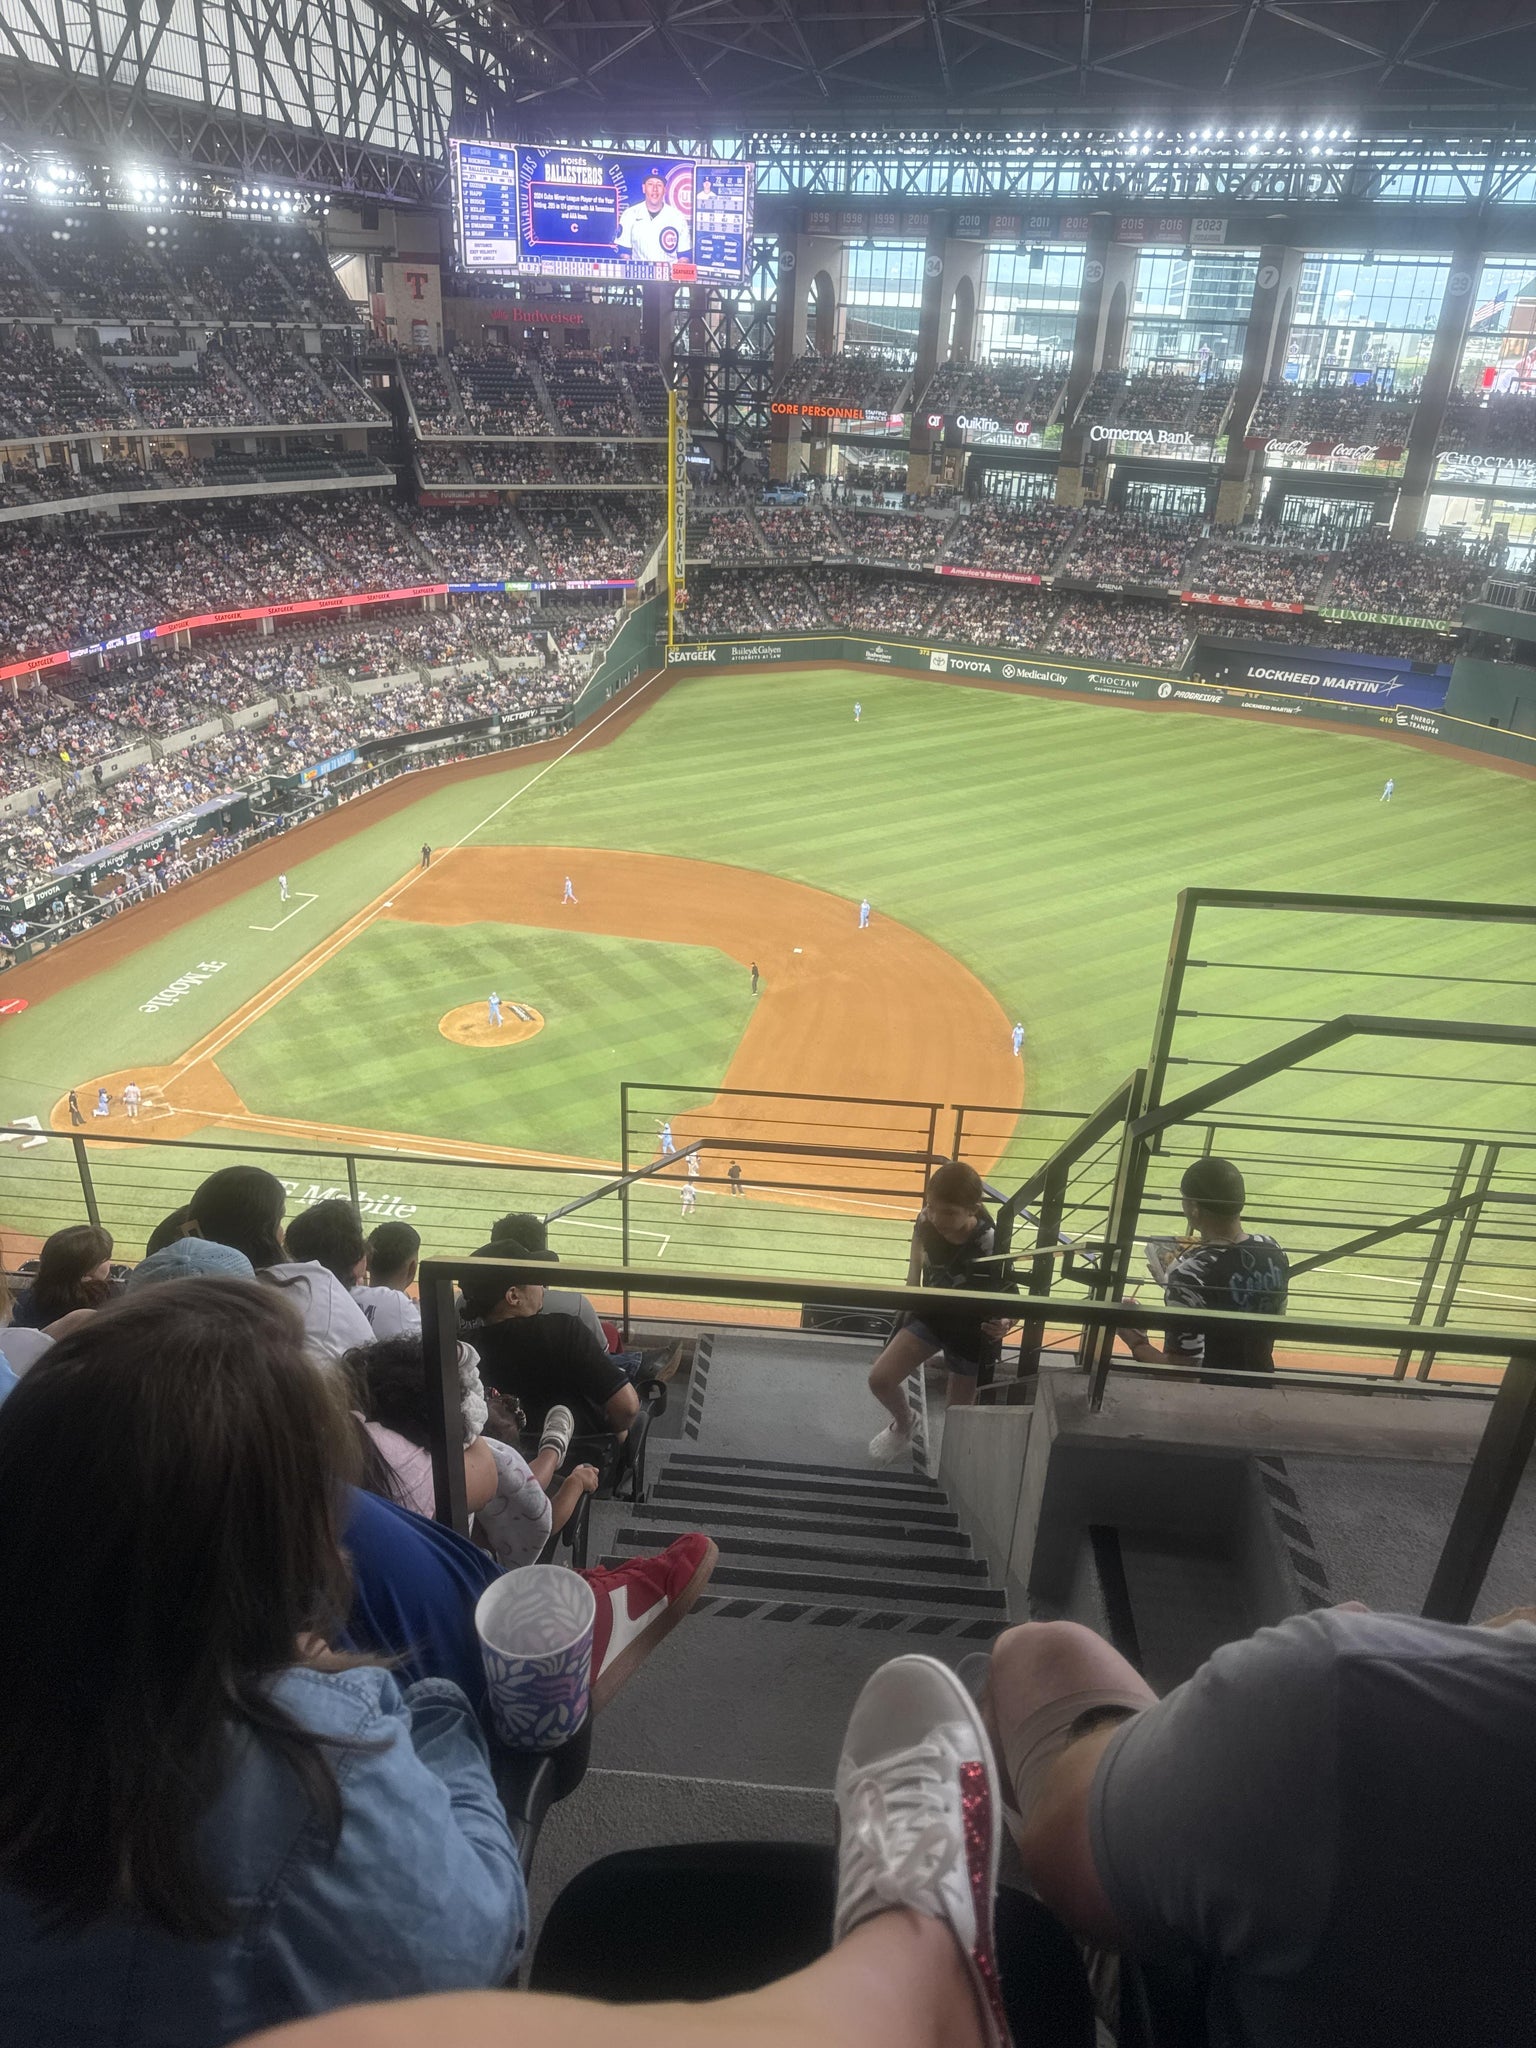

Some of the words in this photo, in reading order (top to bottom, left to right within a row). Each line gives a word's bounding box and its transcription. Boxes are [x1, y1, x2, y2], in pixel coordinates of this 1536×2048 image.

[561, 157, 587, 166] MOISÉS
[544, 163, 603, 185] BALLESTEROS
[1196, 220, 1223, 231] 2023
[927, 261, 941, 273] 34
[1263, 270, 1273, 285] 7
[404, 272, 429, 300] T
[513, 308, 582, 324] Budweiser
[771, 403, 799, 415] CORE
[801, 405, 865, 420] PERSONNEL
[928, 415, 942, 427] QT
[956, 415, 1000, 433] QuikTrip
[1015, 422, 1030, 434] QT
[1158, 429, 1195, 445] Bank
[950, 567, 985, 578] America's
[985, 571, 1001, 580] Best
[1002, 572, 1032, 583] Network
[412, 587, 435, 595] SEATGEEK
[1096, 583, 1124, 591] ARENA
[367, 593, 391, 601] SEATGEEK
[1191, 592, 1211, 600] DEX
[1218, 595, 1238, 603] DEX
[1244, 598, 1265, 606] DEX
[268, 606, 294, 615] SEATGEEK
[318, 599, 344, 608] SEATGEEK
[214, 612, 242, 622] SEATGEEK
[1330, 608, 1378, 623] LUXOR
[1379, 613, 1446, 631] STAFFING
[668, 649, 717, 663] SEATGEEK
[950, 659, 992, 673] TOYOTA
[1016, 668, 1049, 681] Medical
[1050, 672, 1068, 685] City
[1087, 674, 1140, 688] CHOCTAW
[1247, 666, 1320, 685] LOCKHEED
[1322, 676, 1380, 694] MARTIN
[1173, 690, 1224, 704] PROGRESSIVE
[1241, 701, 1271, 711] LOCKHEED
[1270, 705, 1293, 713] MARTIN
[501, 709, 535, 723] VICTORY
[1379, 716, 1393, 724] 410
[1410, 714, 1435, 725] ENERGY
[1408, 721, 1439, 734] TRANSFER
[143, 836, 164, 851] Kroger
[107, 852, 129, 867] Kroger
[36, 885, 61, 901] TOYOTA
[138, 971, 212, 1013] Mobile
